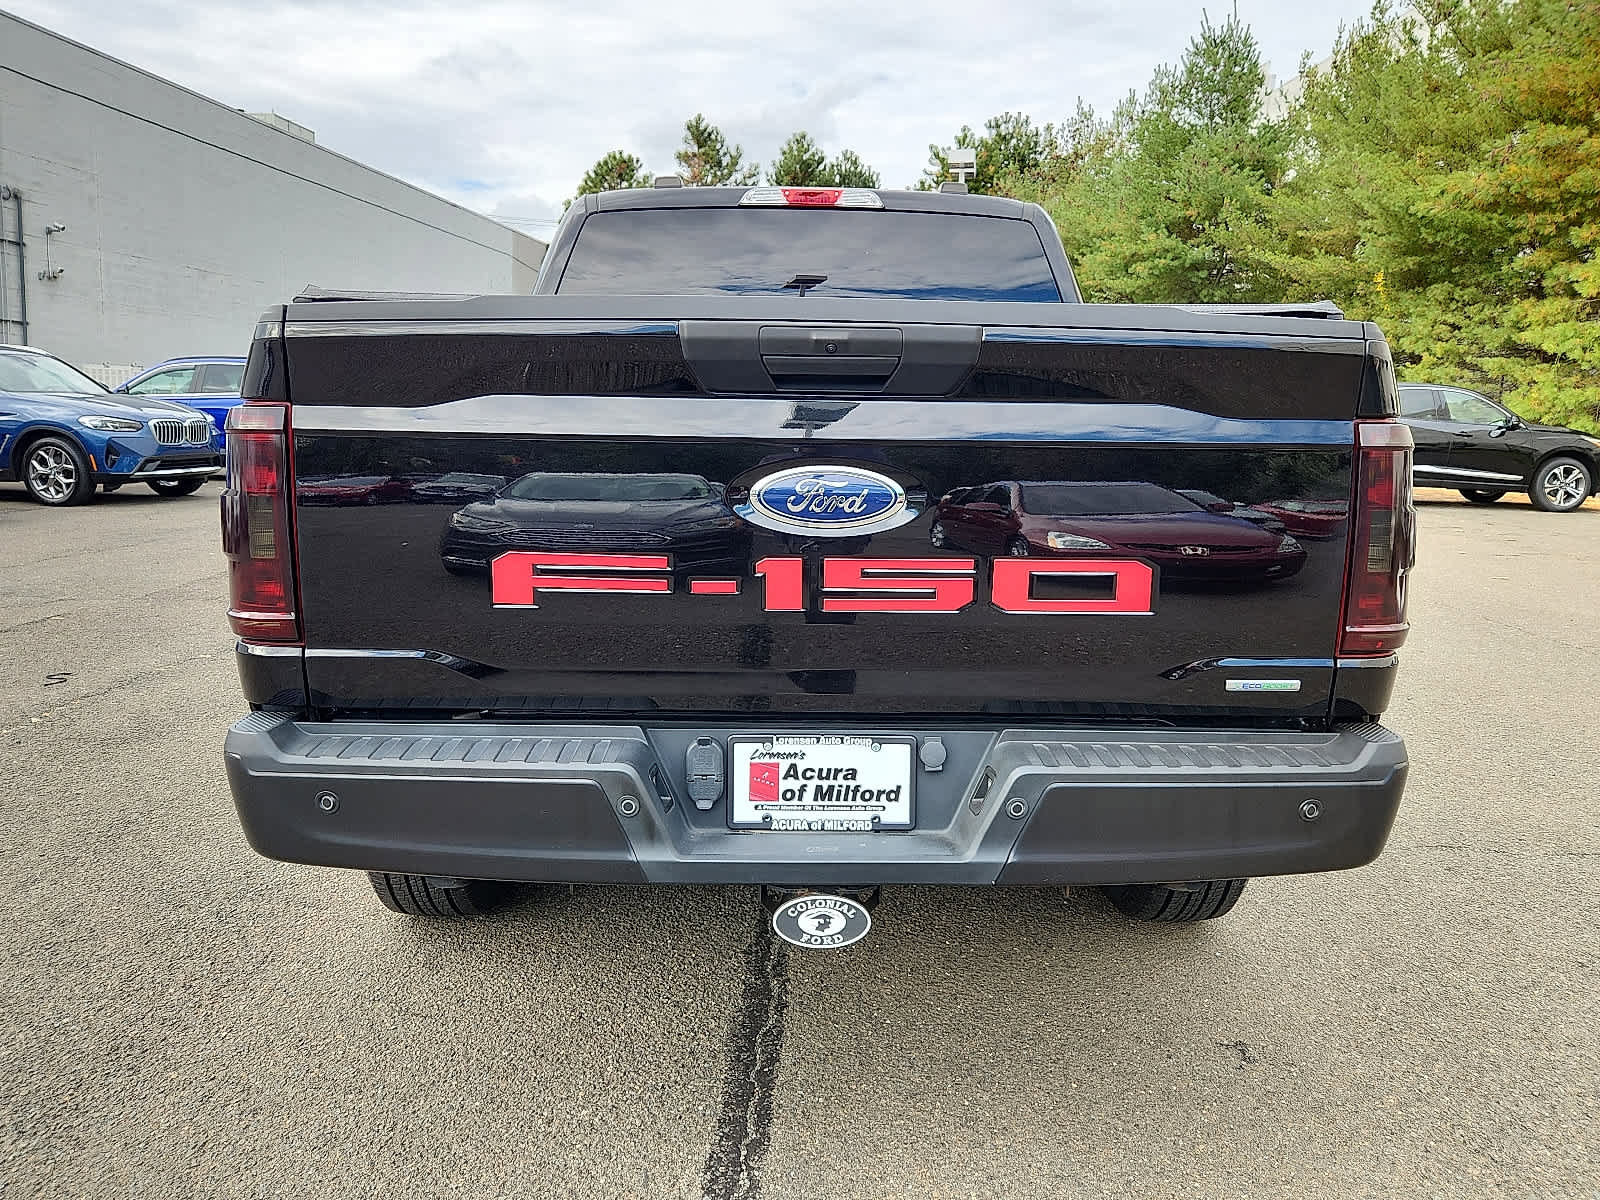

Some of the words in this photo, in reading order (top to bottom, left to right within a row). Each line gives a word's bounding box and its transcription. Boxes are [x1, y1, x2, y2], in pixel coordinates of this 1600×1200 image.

[787, 478, 869, 513] Ford
[491, 550, 1157, 615] F-150
[819, 736, 842, 746] Auto
[843, 736, 873, 748] Group
[750, 748, 806, 760] Lorensen's
[782, 763, 857, 781] Acura
[781, 784, 808, 802] of
[813, 784, 902, 803] Milford
[771, 819, 809, 830] ACURA
[810, 819, 824, 830] of
[823, 819, 873, 831] MILFORD
[787, 899, 857, 919] COLONIAL
[799, 933, 844, 945] FORD
